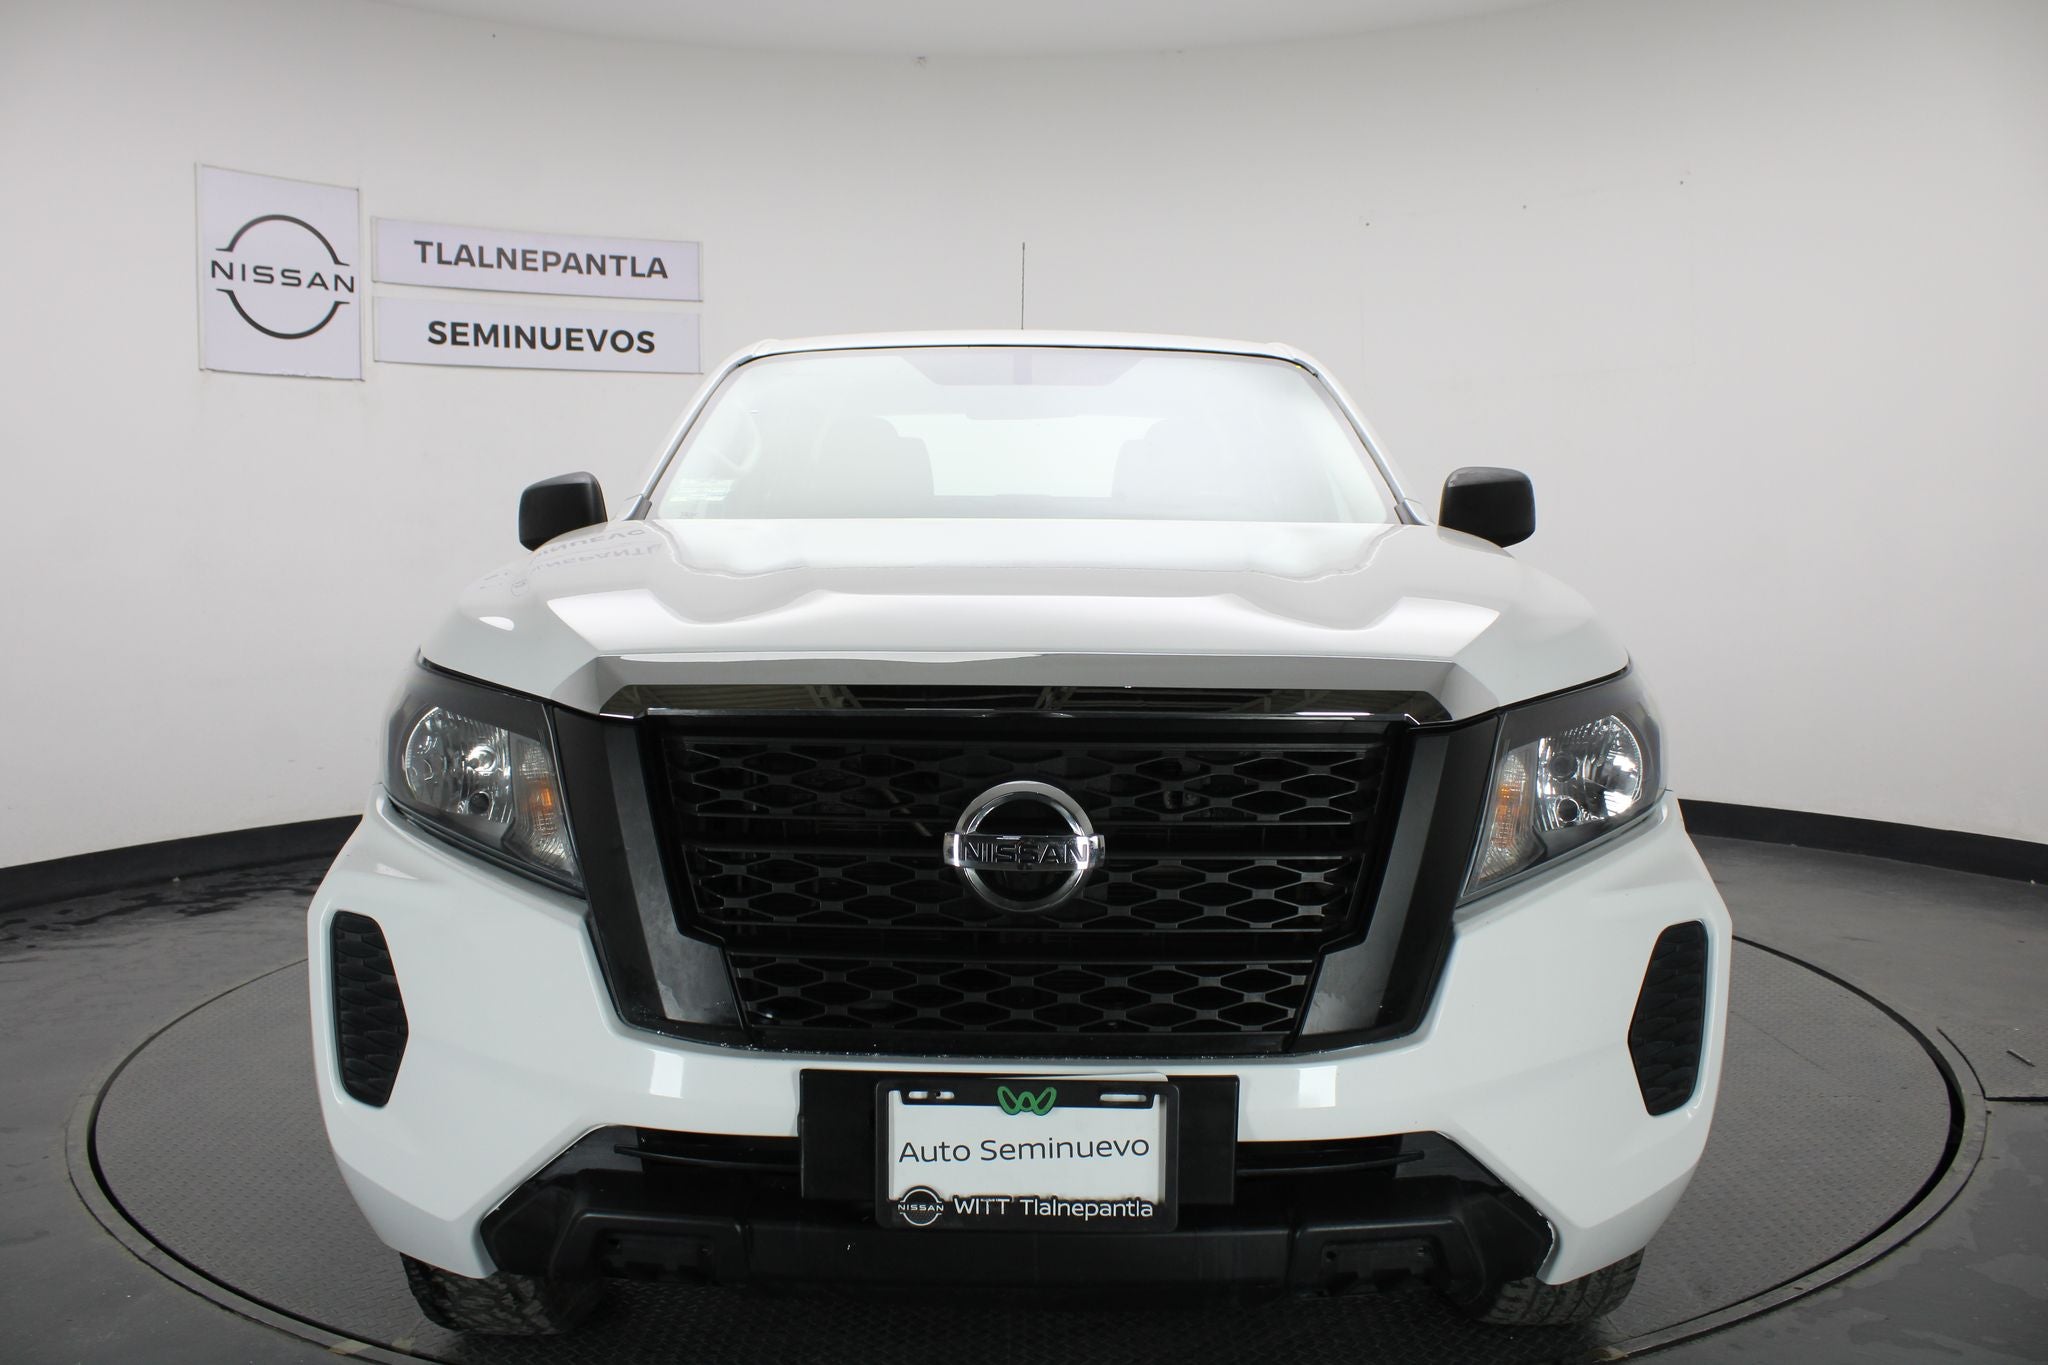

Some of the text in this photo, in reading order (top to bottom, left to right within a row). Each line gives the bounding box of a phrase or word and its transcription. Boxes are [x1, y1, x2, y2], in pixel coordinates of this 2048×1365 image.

[414, 240, 668, 279] TLALNEPANTLA
[211, 260, 354, 293] NISSAN
[427, 320, 655, 354] SEMINUEVOS
[960, 842, 1090, 864] NISSAN
[899, 1138, 1150, 1163] Auto Seminuevo
[897, 1203, 944, 1212] NISSAN
[953, 1198, 1153, 1221] WITT Tlalnepantla
